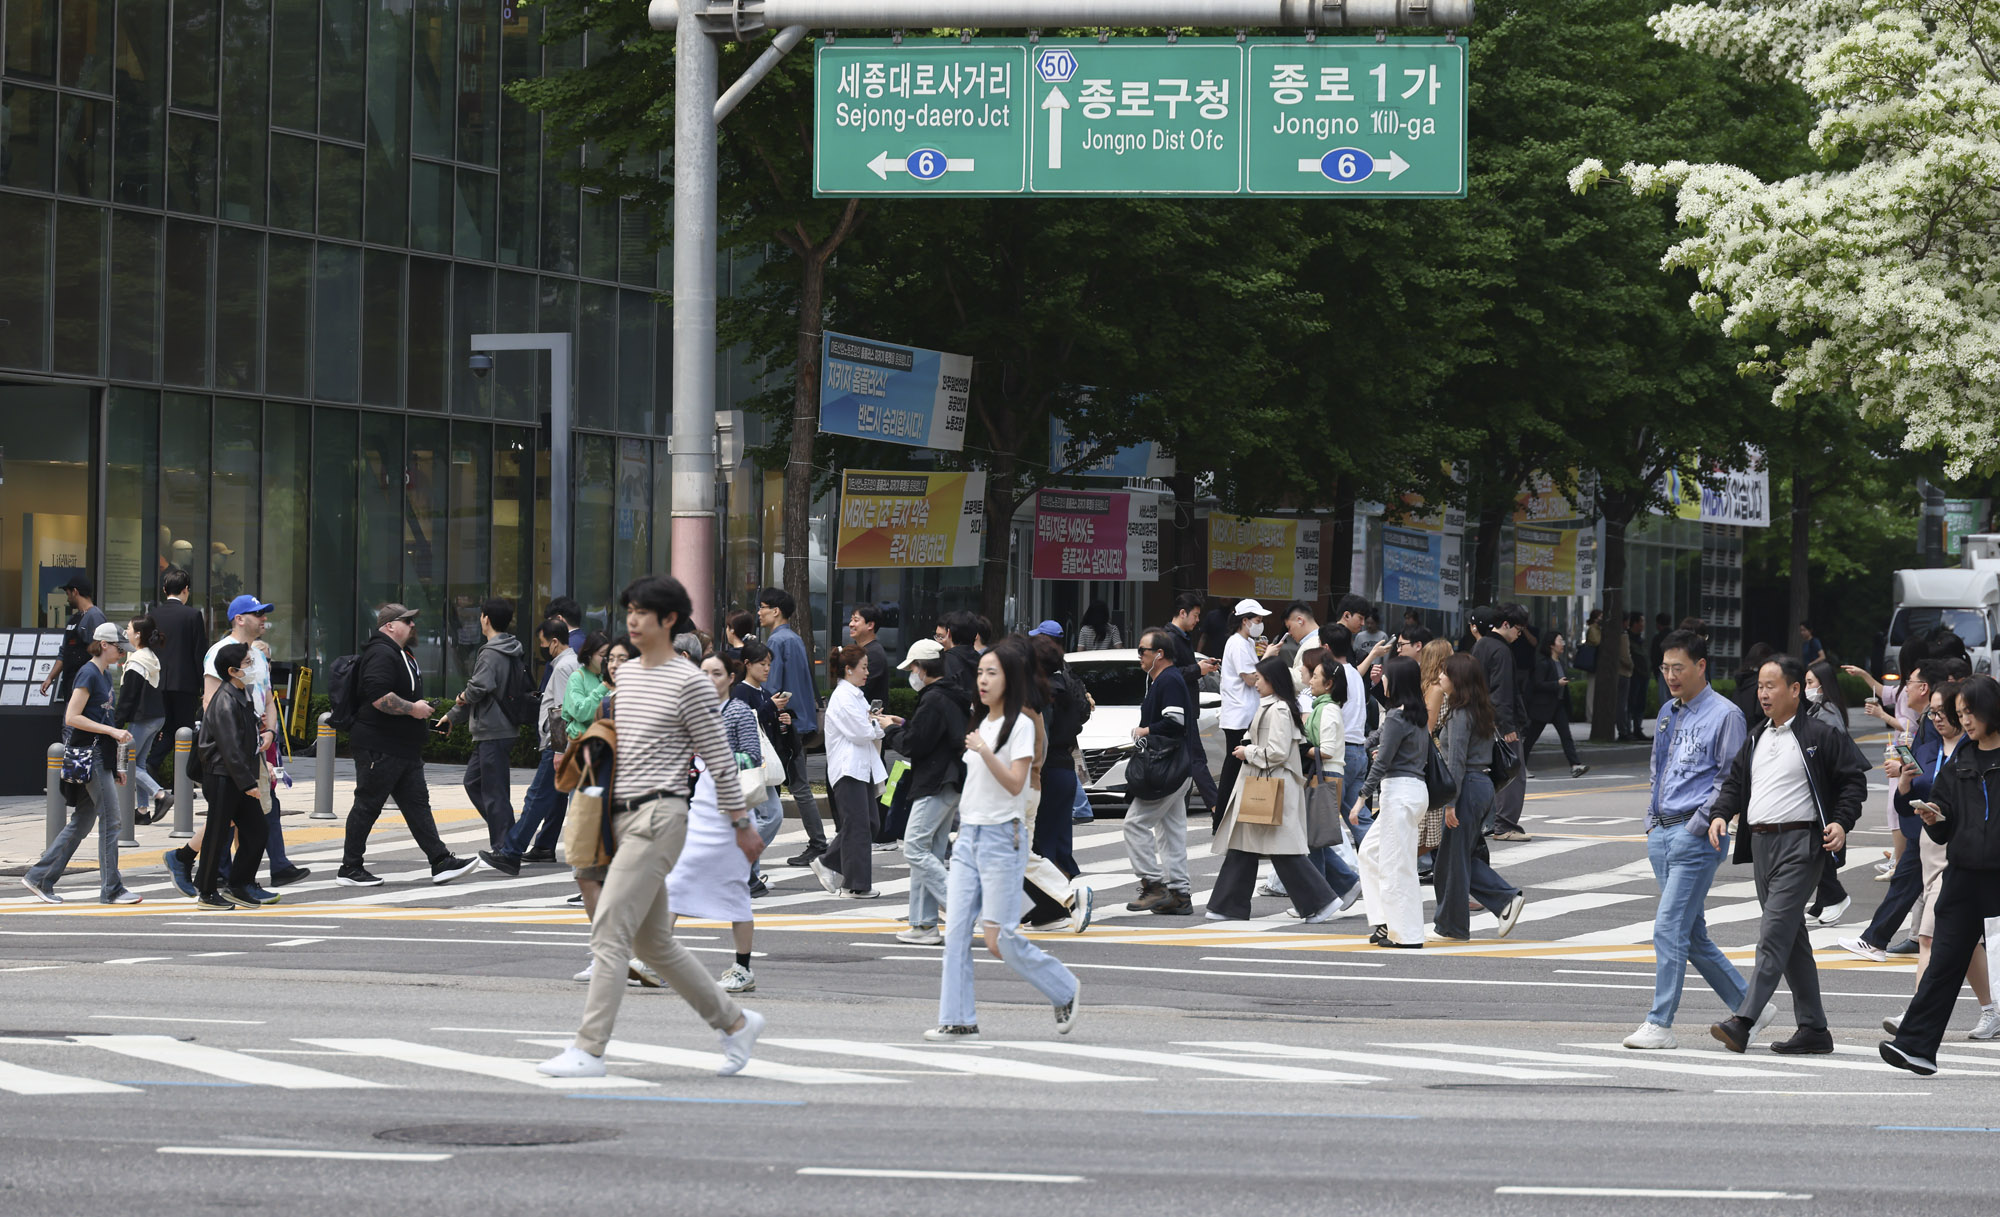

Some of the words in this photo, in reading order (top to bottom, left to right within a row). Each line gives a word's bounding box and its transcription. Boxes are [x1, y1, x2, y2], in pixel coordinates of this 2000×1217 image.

[836, 62, 1012, 99] 세종대로사거리
[1045, 55, 1068, 78] 50
[1078, 78, 1230, 120] 종로구청
[836, 103, 974, 131] Sejong-daero
[978, 104, 1010, 128] Jct
[1273, 112, 1359, 140] Jongno
[1082, 129, 1146, 154] Jongno
[1153, 128, 1185, 151] Dist
[1191, 128, 1224, 151] Ofc
[918, 152, 934, 176] 6
[1339, 154, 1355, 178] 6
[827, 362, 852, 392] 지키자
[857, 404, 882, 433] 반드시
[882, 407, 924, 439] 승리합시다!
[945, 415, 965, 432] 노동조합
[843, 498, 876, 529] MBK는
[891, 499, 912, 528] 투자
[910, 500, 930, 529] 약속
[963, 500, 983, 515] 프로젝트
[1038, 514, 1068, 543] 먹튀자본
[1067, 517, 1095, 544] MBK는
[52, 553, 77, 568] LifeWear
[890, 534, 910, 564] 즉각
[909, 533, 948, 564] 이행하라
[1061, 546, 1091, 574] 홈플러스
[1092, 548, 1123, 575] 살려내라!
[1142, 541, 1157, 554] 노동조합
[1684, 742, 1707, 756] 1984
